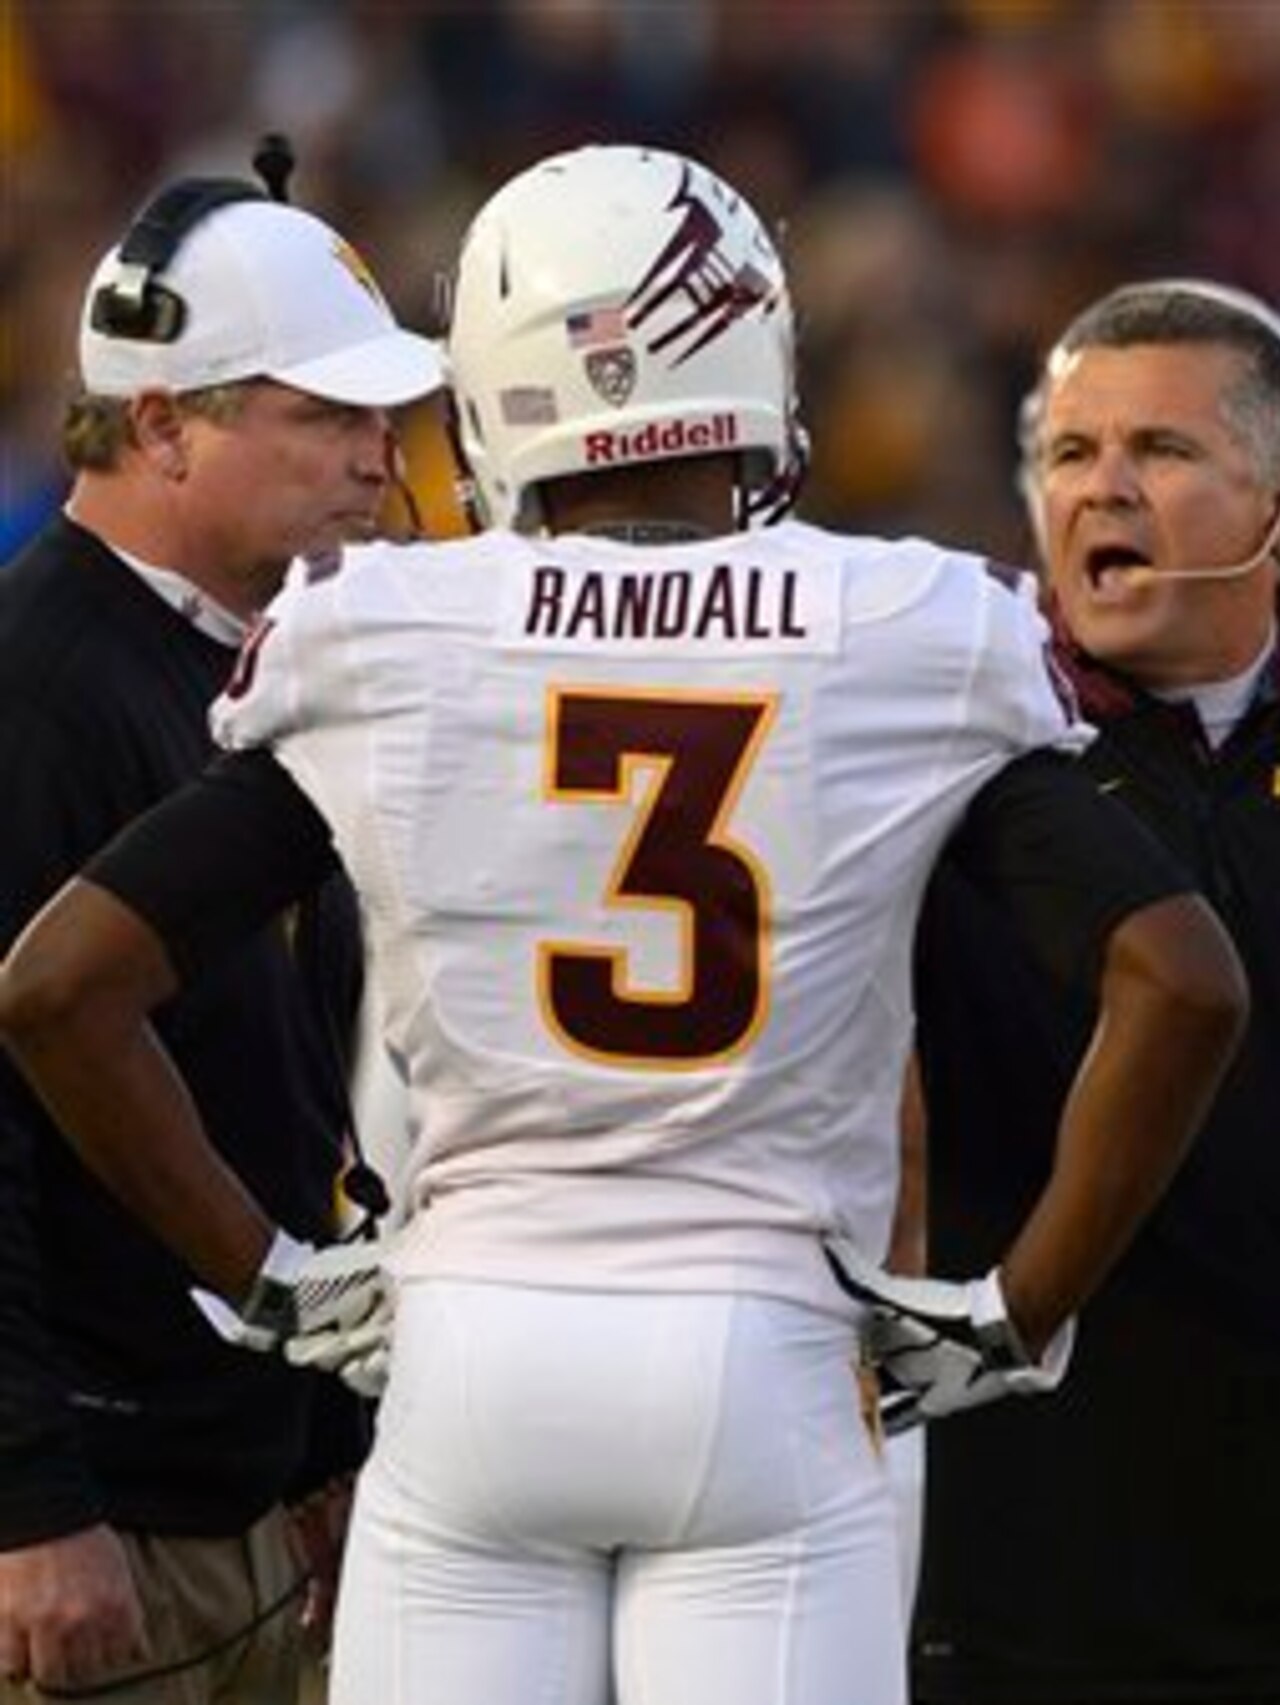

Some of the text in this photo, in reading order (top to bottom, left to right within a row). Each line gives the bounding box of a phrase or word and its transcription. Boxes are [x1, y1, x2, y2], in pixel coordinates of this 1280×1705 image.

[585, 412, 736, 465] Riddell
[524, 565, 808, 640] RANDALL
[536, 684, 783, 1073] 3
